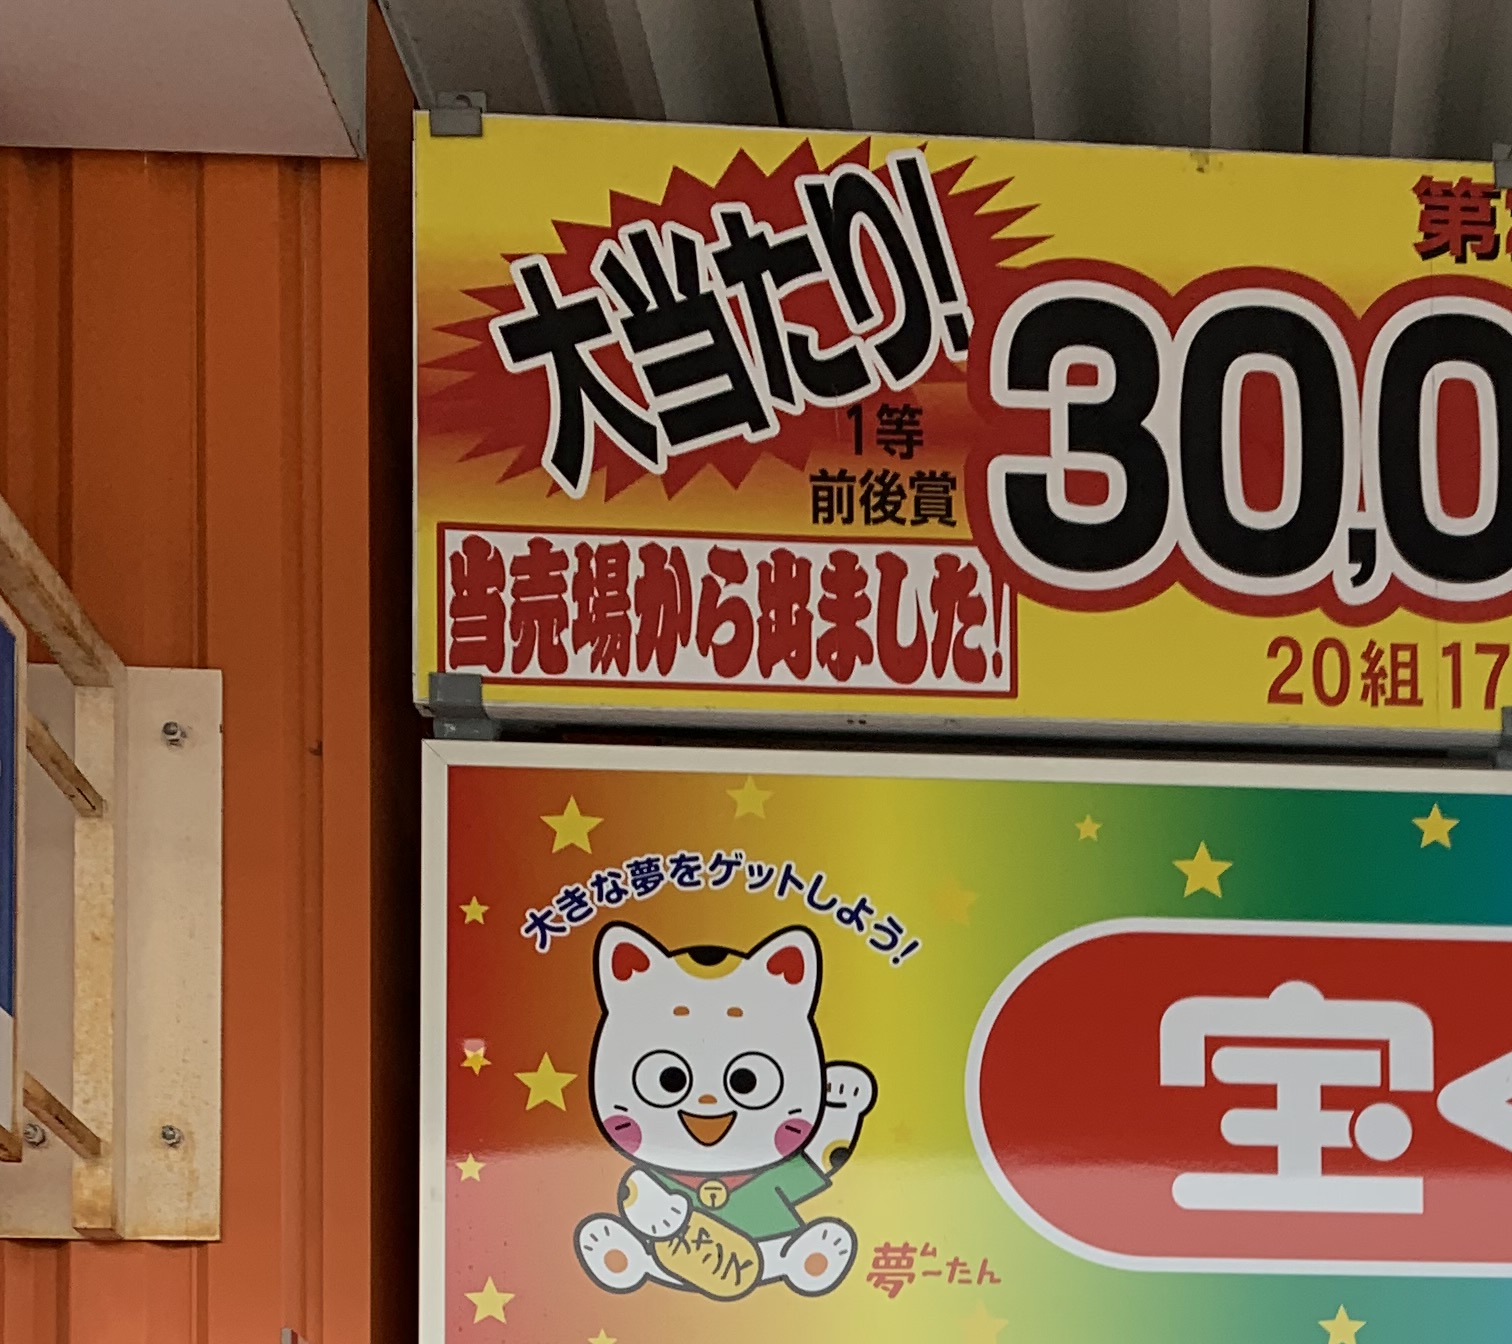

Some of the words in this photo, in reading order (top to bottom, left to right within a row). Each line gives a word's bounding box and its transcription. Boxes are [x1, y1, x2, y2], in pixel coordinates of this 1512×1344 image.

[494, 152, 973, 498] 大当たり!
[844, 402, 923, 460] 1等
[809, 468, 957, 527] 前後賞
[448, 537, 1004, 685] 当売場から出ました!
[521, 850, 922, 965] 大きな夢をゲットしよう!
